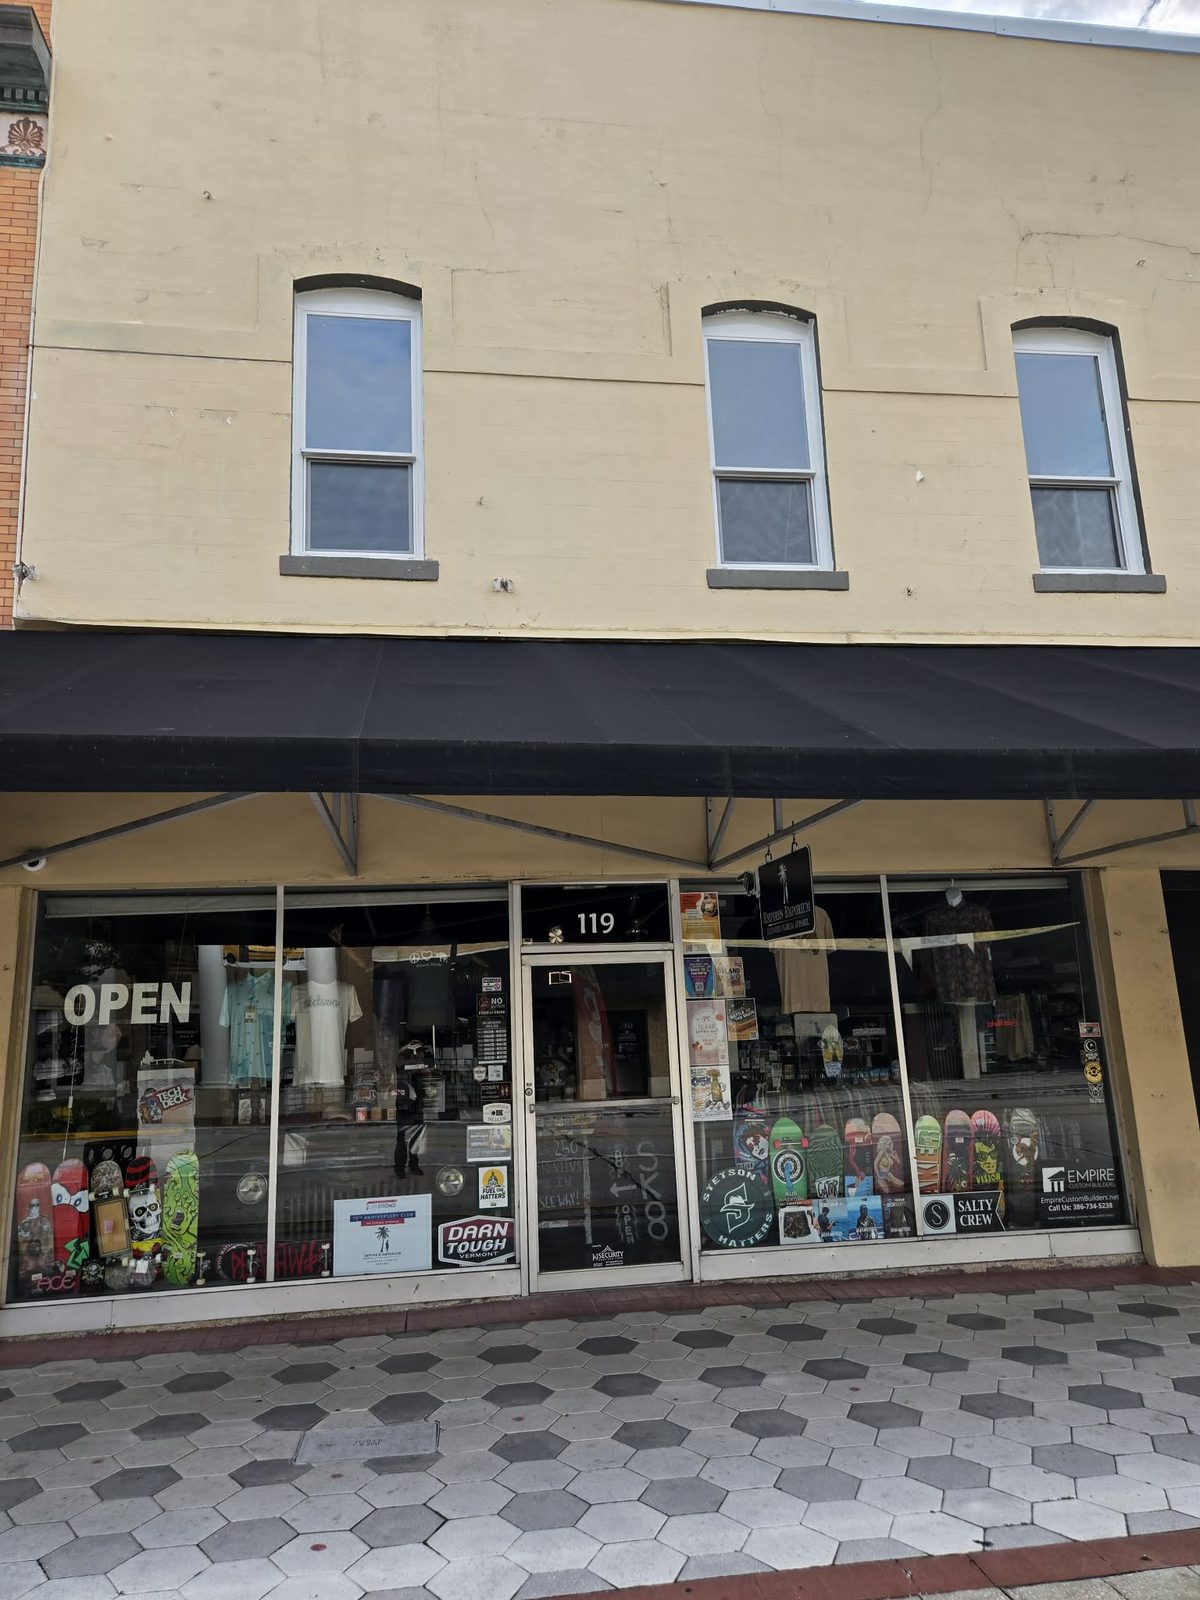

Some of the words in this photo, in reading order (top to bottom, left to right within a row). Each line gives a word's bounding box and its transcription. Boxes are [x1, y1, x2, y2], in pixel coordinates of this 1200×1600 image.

[577, 913, 615, 934] 119
[64, 981, 192, 1026] OPEN
[491, 997, 503, 1005] NO
[156, 1086, 182, 1101] TECH
[161, 1092, 188, 1109] DECK
[976, 1173, 1001, 1184] VISION
[1067, 1168, 1115, 1183] EMPIRE
[703, 1168, 756, 1202] STETSON
[539, 1194, 557, 1209] SEE
[958, 1199, 994, 1212] SALTY
[1040, 1194, 1119, 1204] EmpireCustomBuilders.net
[1048, 1204, 1061, 1212] Call
[1062, 1203, 1072, 1211] Us:
[1073, 1202, 1113, 1210] 386-734-5238
[621, 1204, 635, 1244] OPEN
[959, 1213, 994, 1227] CREW
[448, 1222, 509, 1241] DARN
[718, 1213, 773, 1247] HATTERS
[447, 1238, 507, 1255] TOUGH
[459, 1251, 498, 1259] VERMONT
[37, 1275, 76, 1291] ACE
